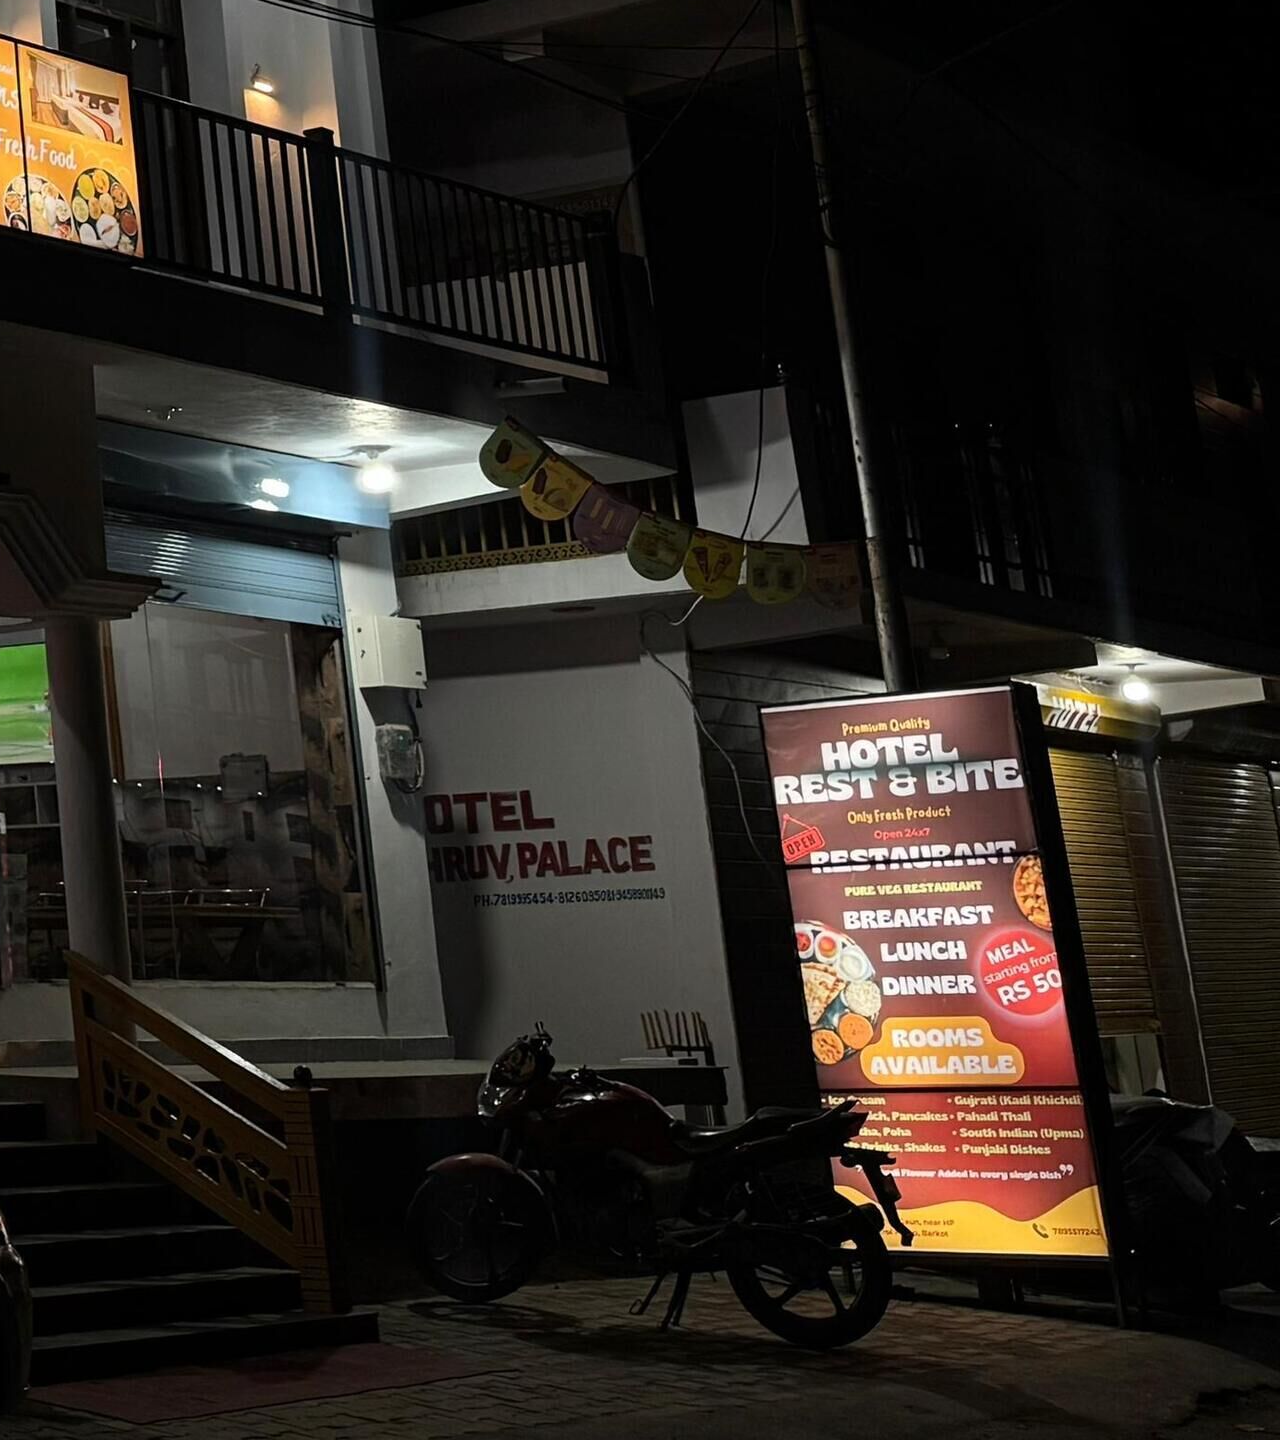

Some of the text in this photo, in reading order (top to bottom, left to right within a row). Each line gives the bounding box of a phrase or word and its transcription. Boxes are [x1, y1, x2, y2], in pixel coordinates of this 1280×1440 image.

[40, 138, 78, 171] Food
[841, 716, 930, 736] Premium Quality
[820, 733, 959, 771] HOTEL
[773, 758, 1024, 805] REST & BITE
[424, 790, 555, 834] OTEL
[847, 805, 951, 825] Only Fresh Product
[874, 827, 930, 841] Open 24x7
[786, 834, 815, 856] OPEN
[516, 835, 656, 879] PALACE
[810, 840, 1017, 874] RESTAURANT
[844, 881, 983, 897] PURE VEG RESTAURANT
[843, 905, 994, 930] BREAKFAST
[880, 940, 967, 962] LUNCH
[986, 938, 1035, 965] MEAL
[984, 951, 1058, 985] starting from
[881, 975, 977, 996] DINNER
[997, 968, 1062, 1006] RS 50
[891, 1028, 984, 1048] ROOMS
[871, 1055, 1017, 1075] AVAILABLE
[828, 1095, 845, 1105] Ice
[954, 1095, 1084, 1108] Gujrati (Kadi Khichdi)
[892, 1111, 949, 1122] Pancakes
[957, 1111, 1032, 1122] Pahadi Thali
[883, 1127, 912, 1137] Poha
[959, 1128, 1084, 1140] South Indian (Upma)
[904, 1142, 947, 1153] Shakes
[962, 1144, 1051, 1157] Punjabi Dishes
[938, 1168, 968, 1178] Added
[969, 1168, 979, 1178] in
[981, 1171, 1008, 1181] every
[1009, 1170, 1039, 1181] single
